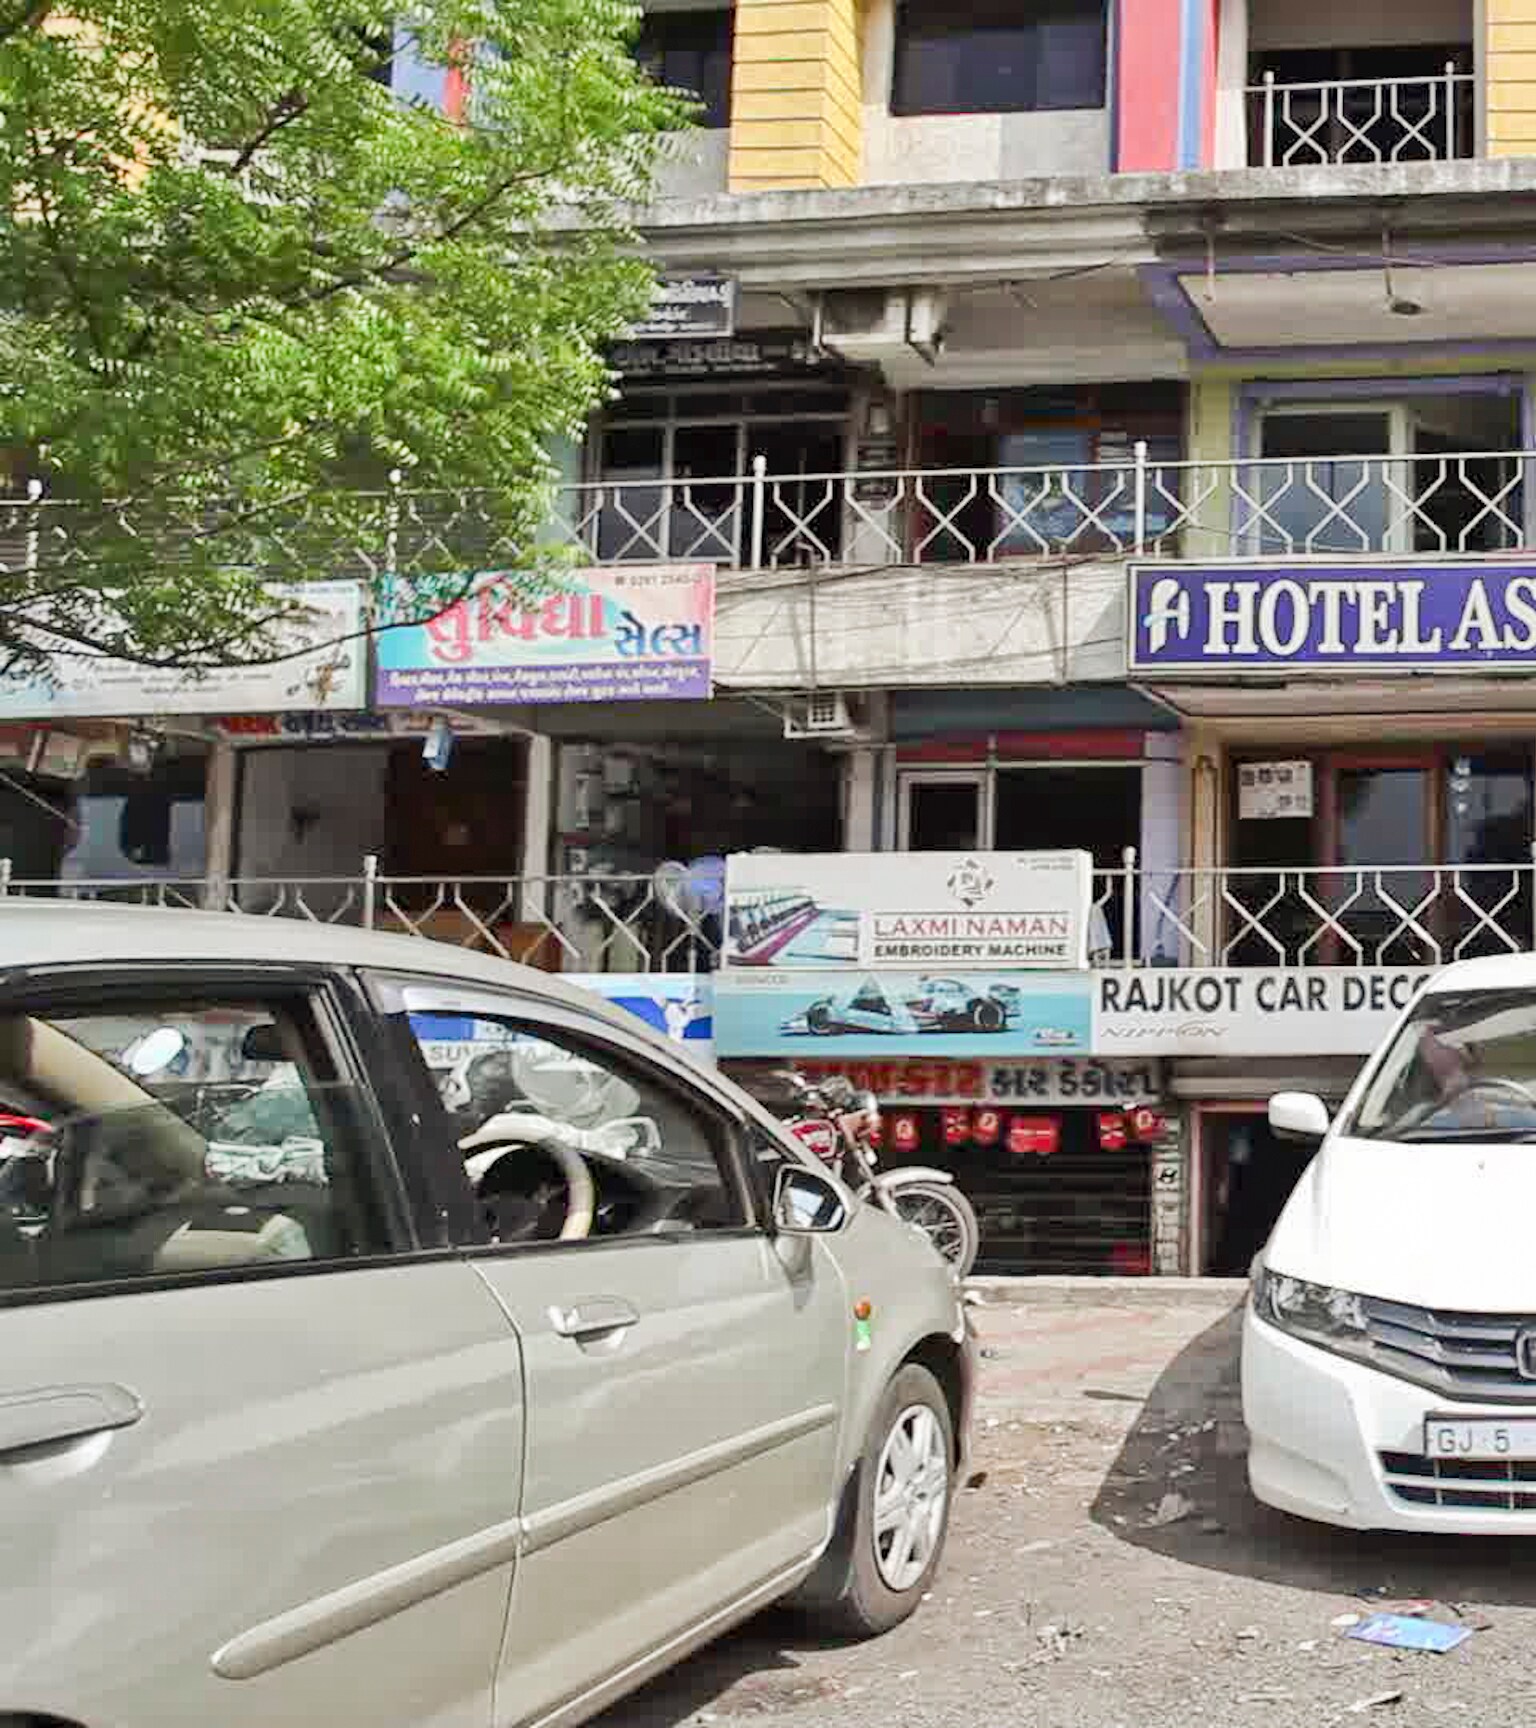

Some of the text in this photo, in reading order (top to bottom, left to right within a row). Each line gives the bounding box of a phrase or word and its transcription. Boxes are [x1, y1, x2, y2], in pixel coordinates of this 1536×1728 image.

[1203, 578, 1441, 656] HOTEL
[873, 917, 1069, 938] LAXMI NAMAN
[874, 943, 1066, 958] EMBROIDERY MACHINE
[1100, 976, 1243, 1013] RAJKOT
[1255, 975, 1330, 1013] CAR
[1436, 1428, 1474, 1454] GJ
[1494, 1428, 1511, 1454] 5
